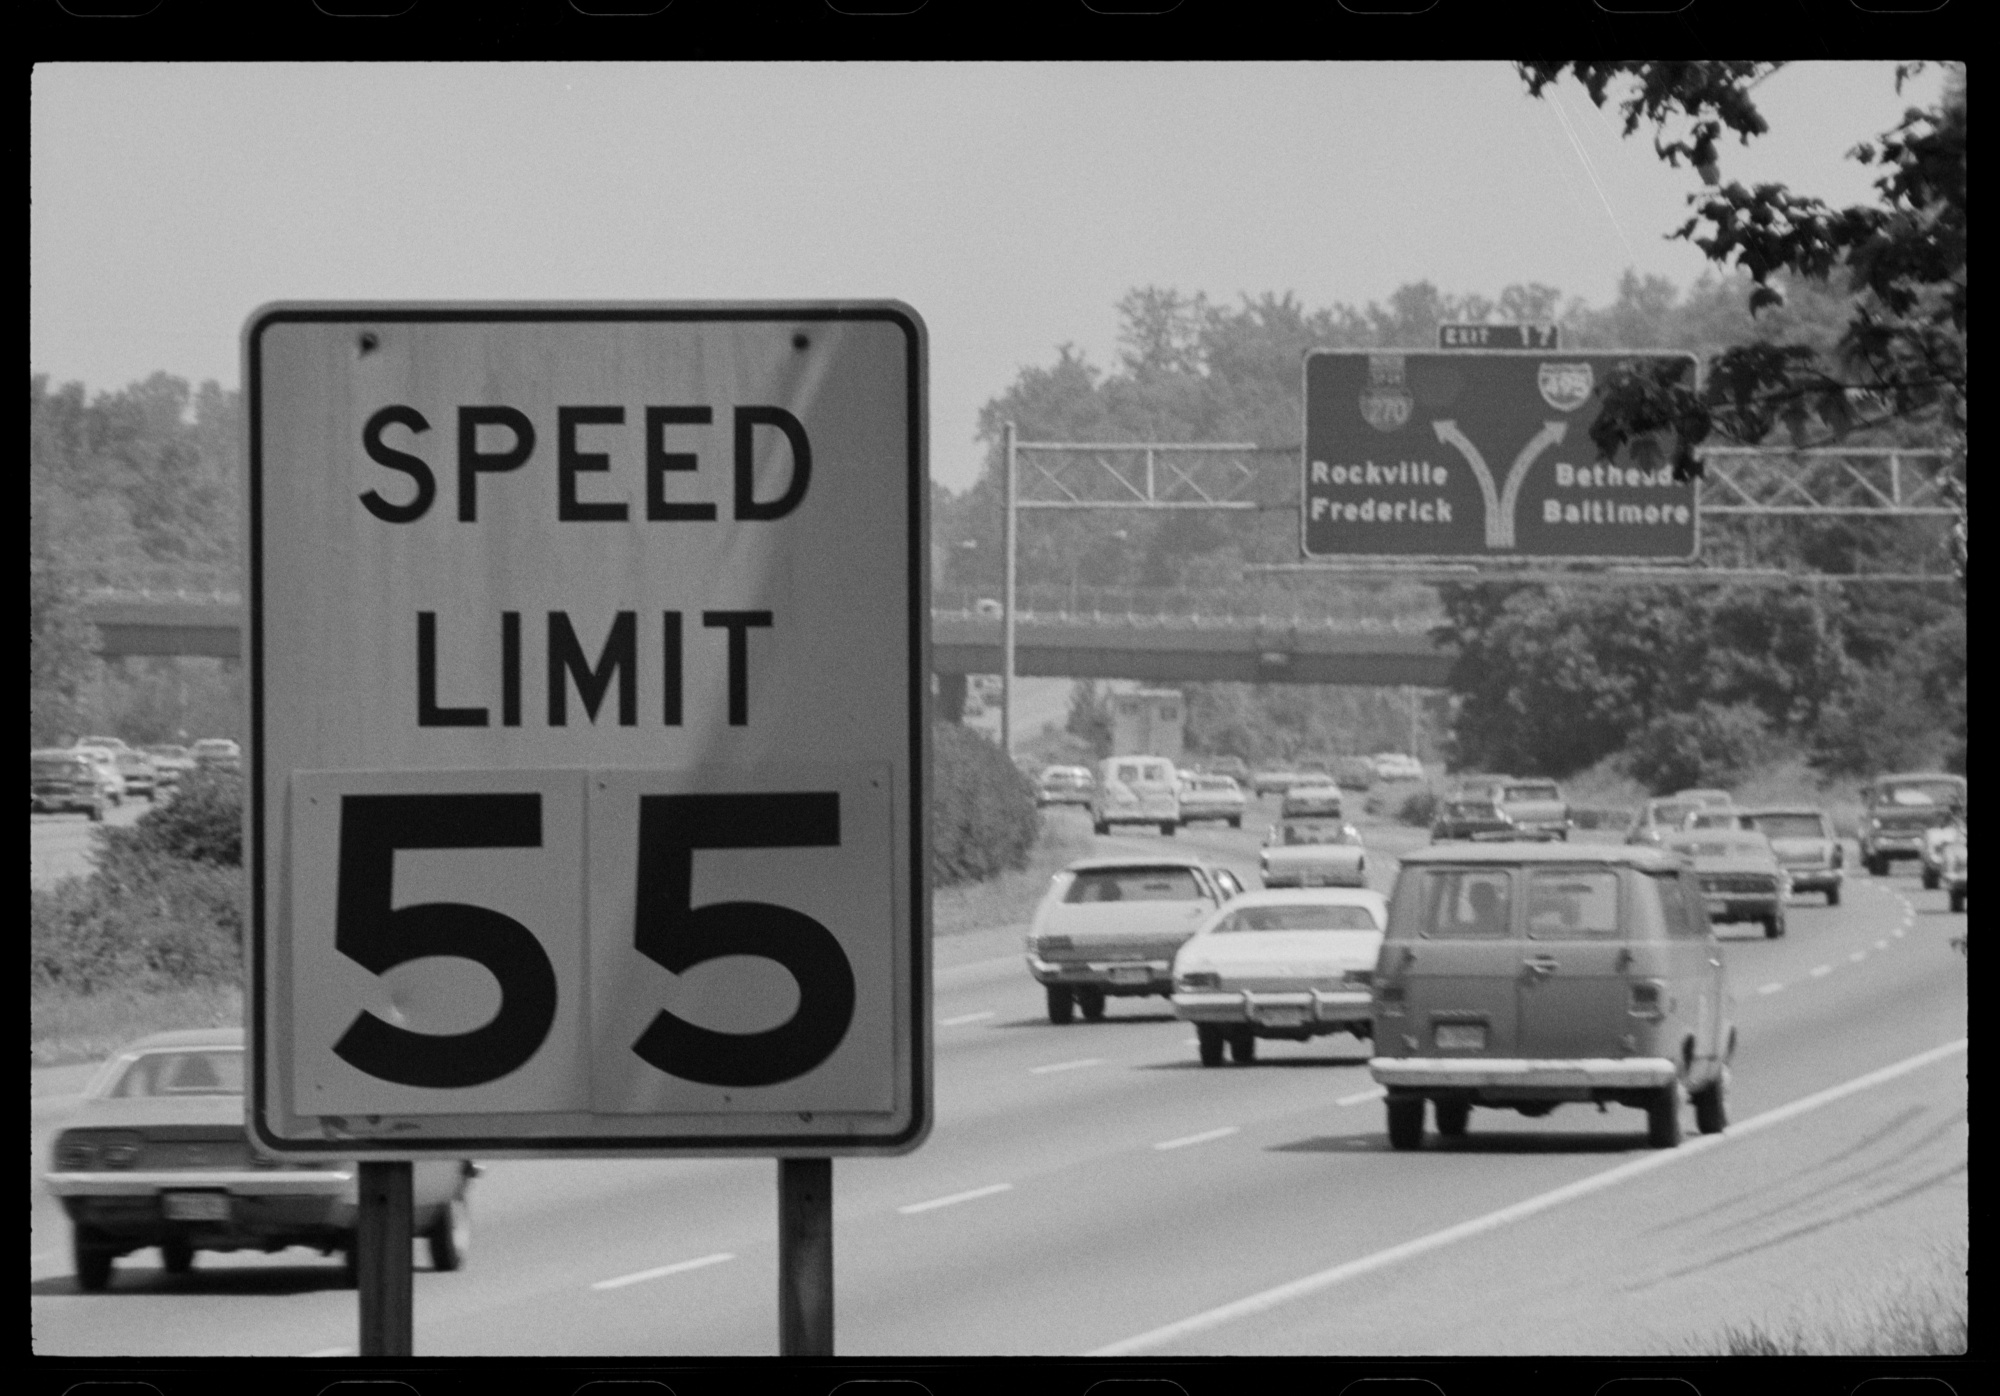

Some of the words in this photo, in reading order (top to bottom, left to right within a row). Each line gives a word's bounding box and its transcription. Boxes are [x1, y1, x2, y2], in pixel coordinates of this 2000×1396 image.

[1445, 328, 1489, 344] EXIT
[1519, 324, 1552, 346] 17
[1542, 371, 1585, 397] 495
[360, 406, 812, 523] SPEED
[1312, 460, 1448, 485] Rockville
[1311, 498, 1452, 522] Frederick
[1543, 499, 1690, 524] Baltimore
[418, 610, 773, 726] LIMIT
[333, 791, 856, 1088] 55
